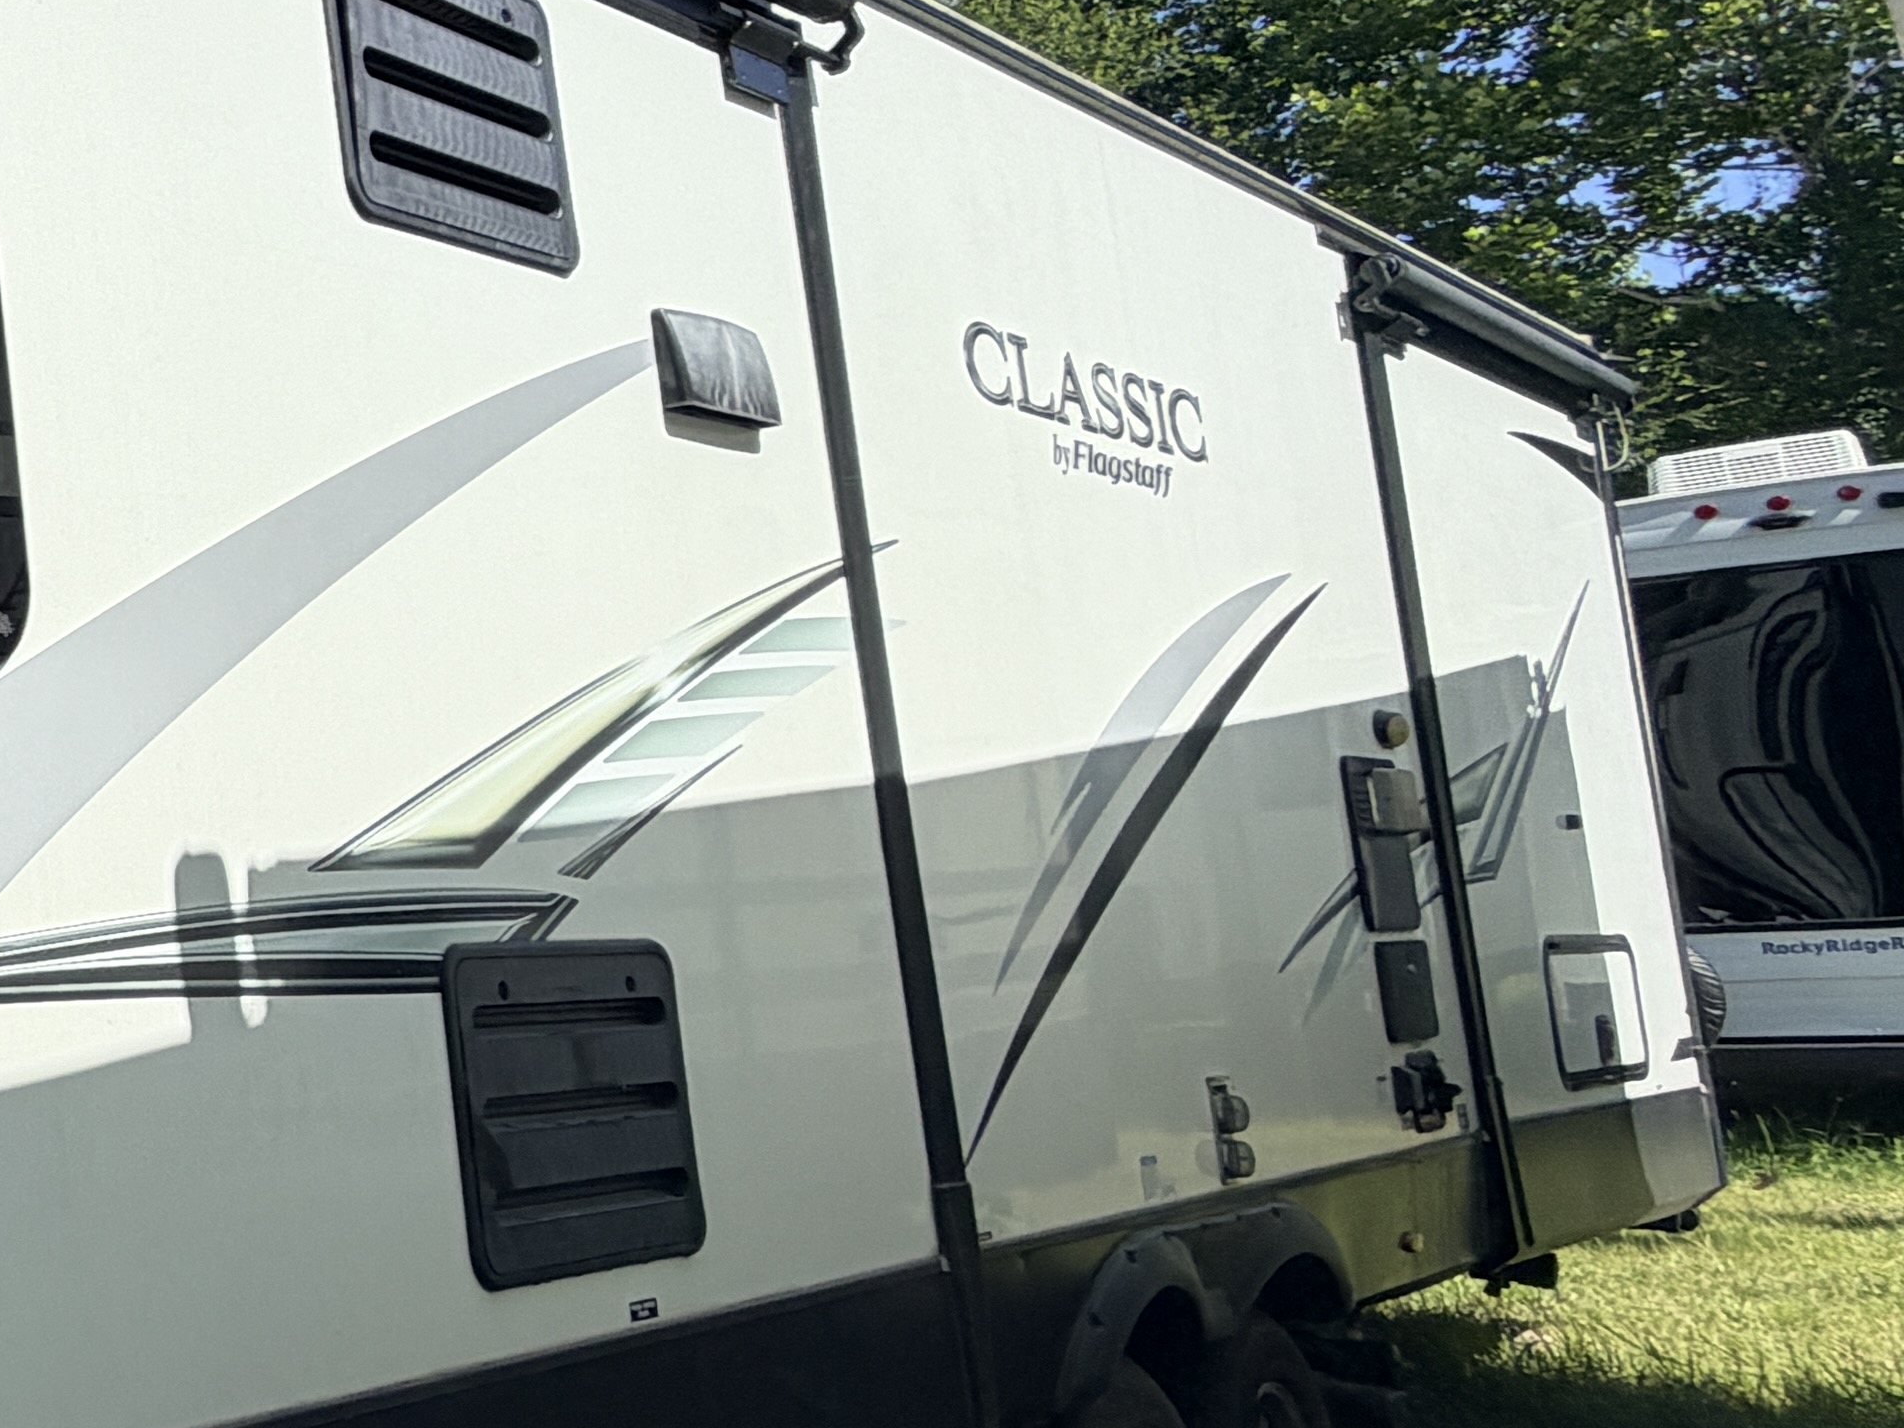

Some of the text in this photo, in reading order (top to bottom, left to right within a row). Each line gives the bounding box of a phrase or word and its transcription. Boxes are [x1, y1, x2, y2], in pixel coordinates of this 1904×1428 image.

[963, 321, 1209, 463] CLASSIC
[1052, 434, 1174, 498] by Flagstaff
